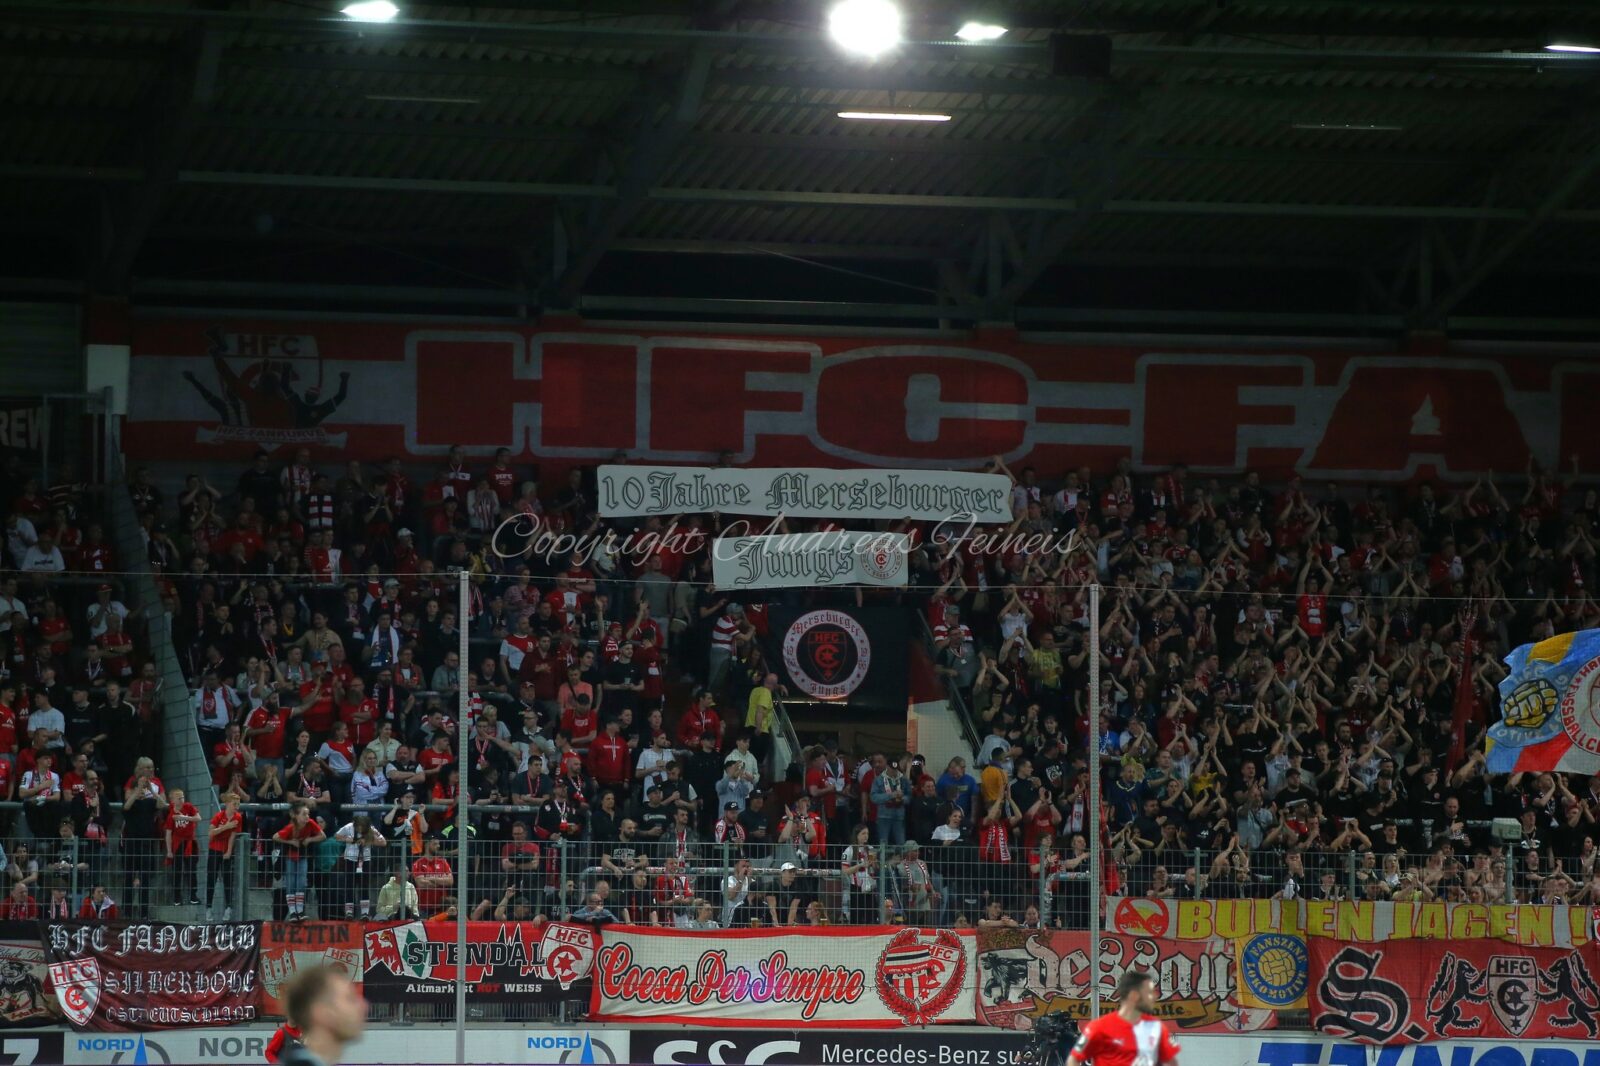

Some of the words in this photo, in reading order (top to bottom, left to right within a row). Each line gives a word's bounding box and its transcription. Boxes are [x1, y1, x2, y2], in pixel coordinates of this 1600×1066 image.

[236, 334, 300, 356] HFC
[764, 471, 1004, 523] Merseburger
[734, 539, 854, 585] Jungs
[791, 611, 861, 636] Merseburger
[815, 632, 840, 643] HFC
[809, 682, 846, 695] Jungs
[1177, 899, 1375, 942] BULLEN
[1388, 902, 1553, 946] JAGEN
[48, 923, 109, 956] HFC
[114, 923, 256, 957] FANCLUB
[271, 924, 350, 944] WETTIN
[555, 928, 589, 946] HFC
[330, 948, 354, 964] HFC
[407, 941, 547, 967] STENDAL
[53, 962, 95, 984] HFC
[1496, 959, 1530, 975] HFC
[103, 965, 256, 998] SILBERHÖHE
[405, 983, 455, 993] Altmark
[504, 983, 543, 993] WEISS
[598, 941, 690, 1003] Coesa
[688, 949, 752, 1005] Per
[749, 949, 867, 1020] Sempre
[105, 1005, 256, 1024] OSTDEUTSCHLAND
[78, 1038, 134, 1051] NORD
[527, 1037, 582, 1049] NORD
[822, 1043, 989, 1065] Mercedes-Benz
